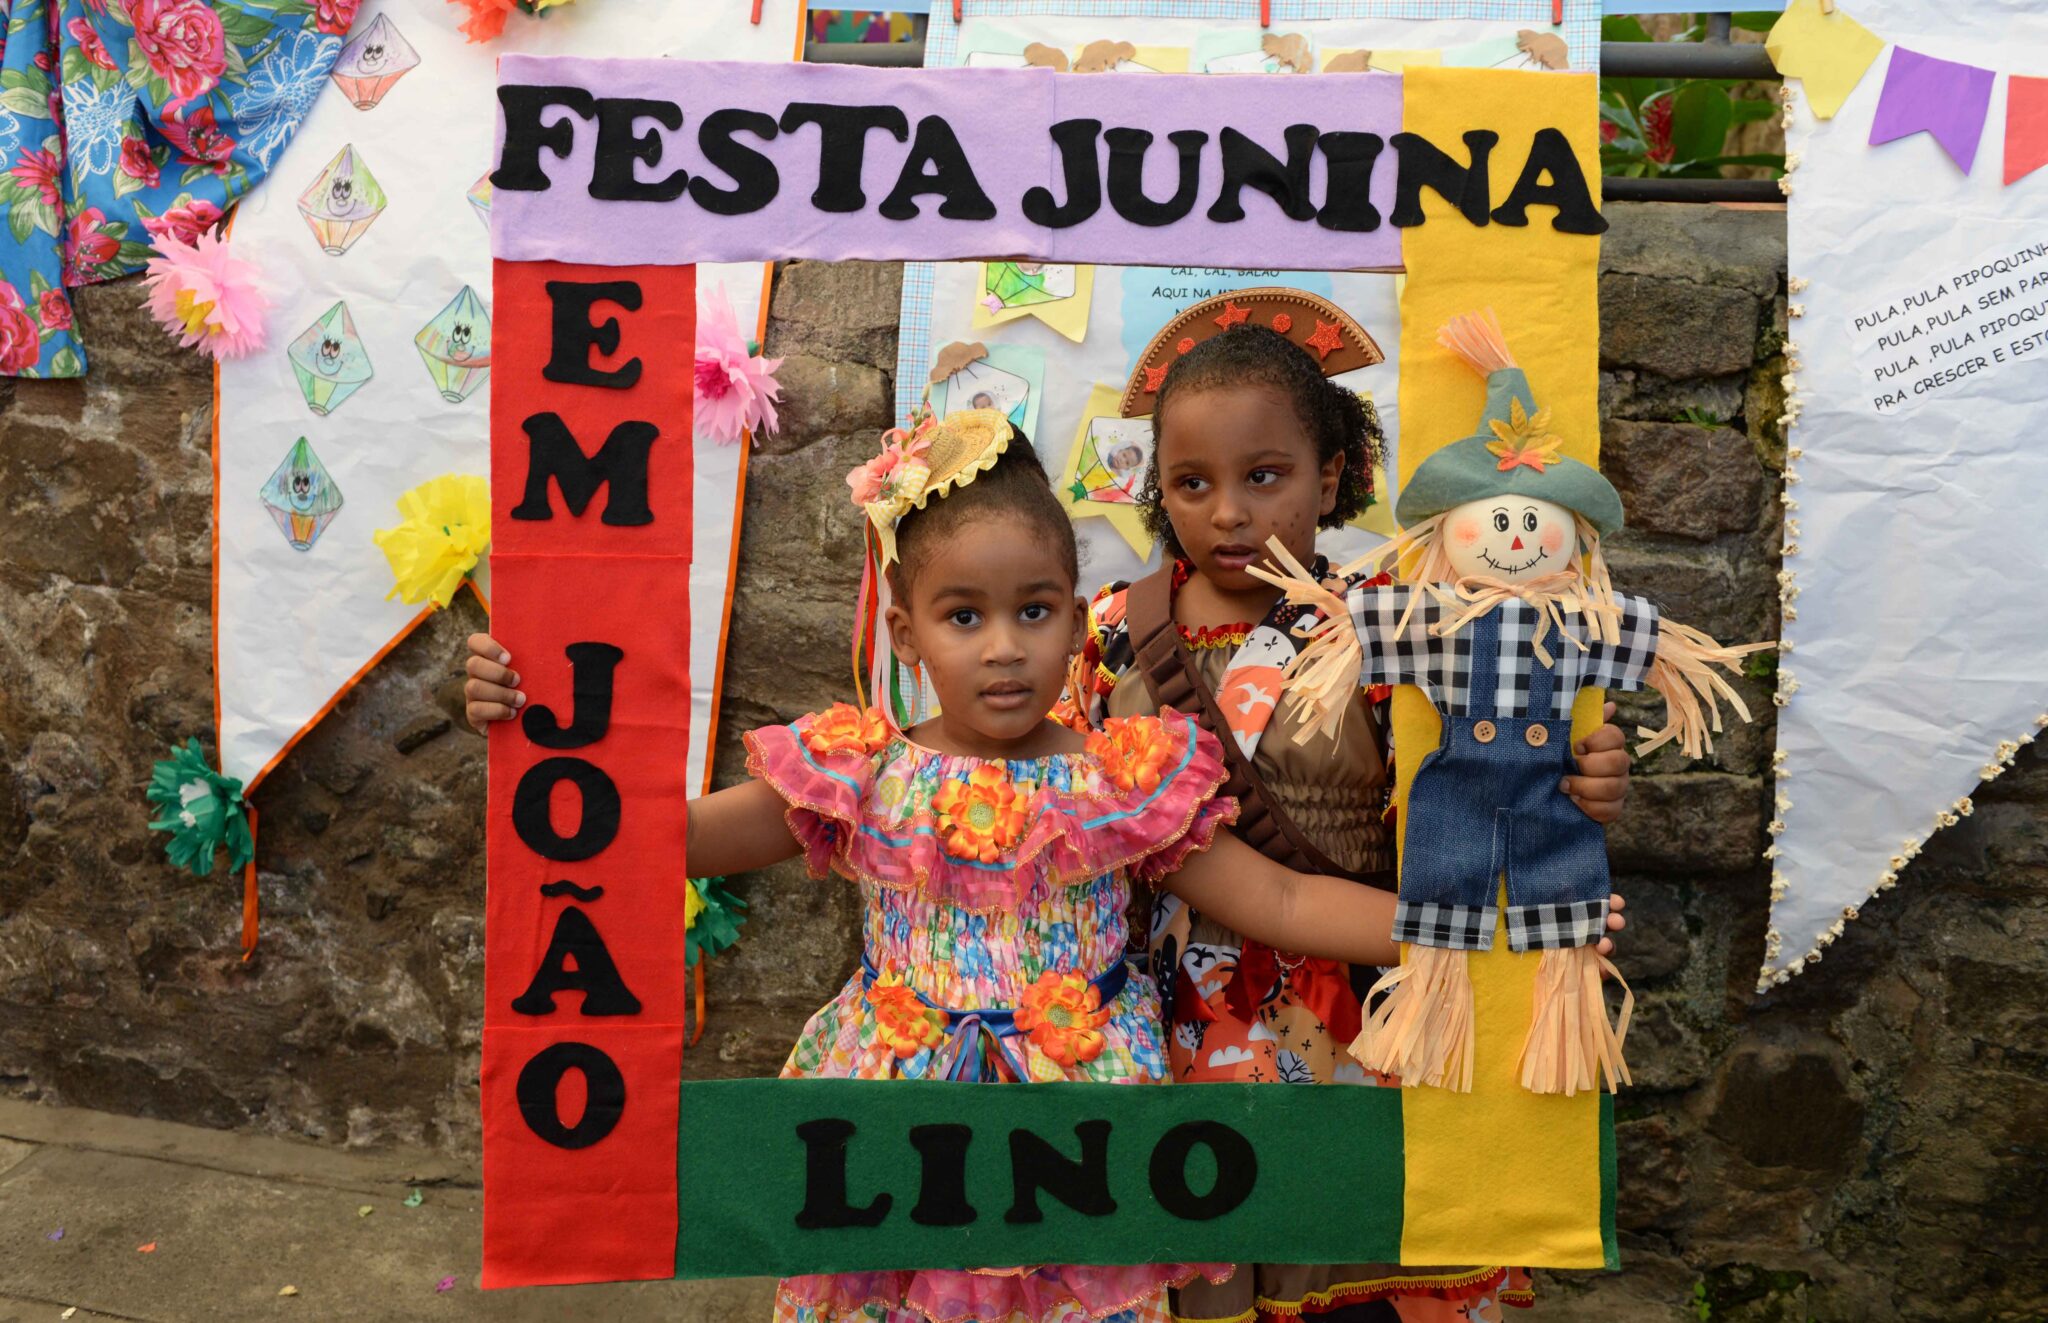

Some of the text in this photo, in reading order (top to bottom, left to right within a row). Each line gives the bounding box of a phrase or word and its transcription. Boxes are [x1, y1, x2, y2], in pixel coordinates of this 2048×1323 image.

[489, 85, 1610, 234] FESTA JUNINA
[1152, 286, 1188, 299] AQUI
[1193, 288, 1212, 298] NA
[1978, 286, 2015, 310] SEM
[511, 281, 660, 526] EM
[1874, 329, 2048, 410] PRA CRESCER E EST
[511, 642, 642, 1150] JOÃO
[795, 1118, 1258, 1229] LINO
